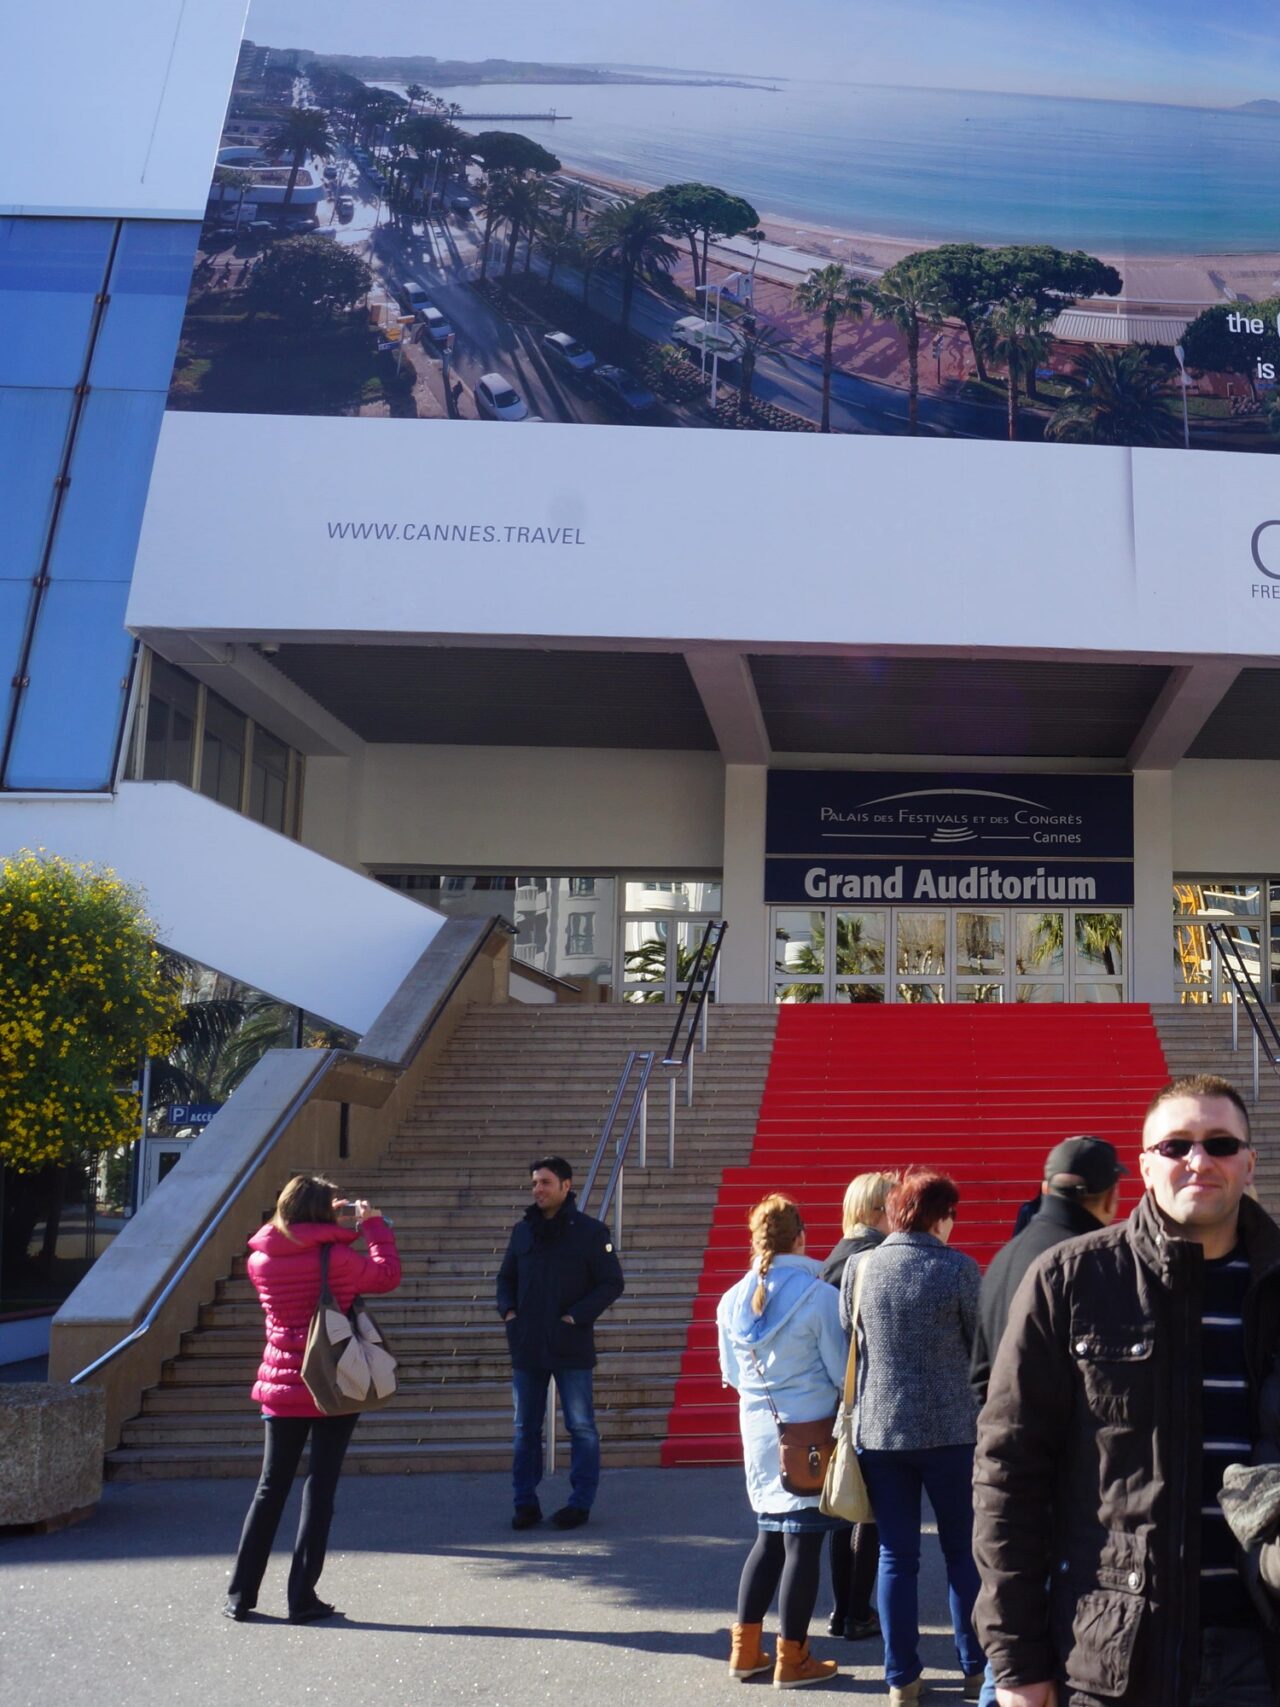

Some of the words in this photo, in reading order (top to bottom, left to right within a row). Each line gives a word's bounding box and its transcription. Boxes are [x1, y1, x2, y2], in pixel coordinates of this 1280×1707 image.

[1226, 311, 1264, 335] the
[1256, 356, 1276, 380] is
[327, 522, 586, 545] WWW.CANNES.TRAVEL
[1033, 831, 1081, 843] Cannes
[804, 865, 904, 900] Grand
[913, 866, 1096, 900] Auditorium
